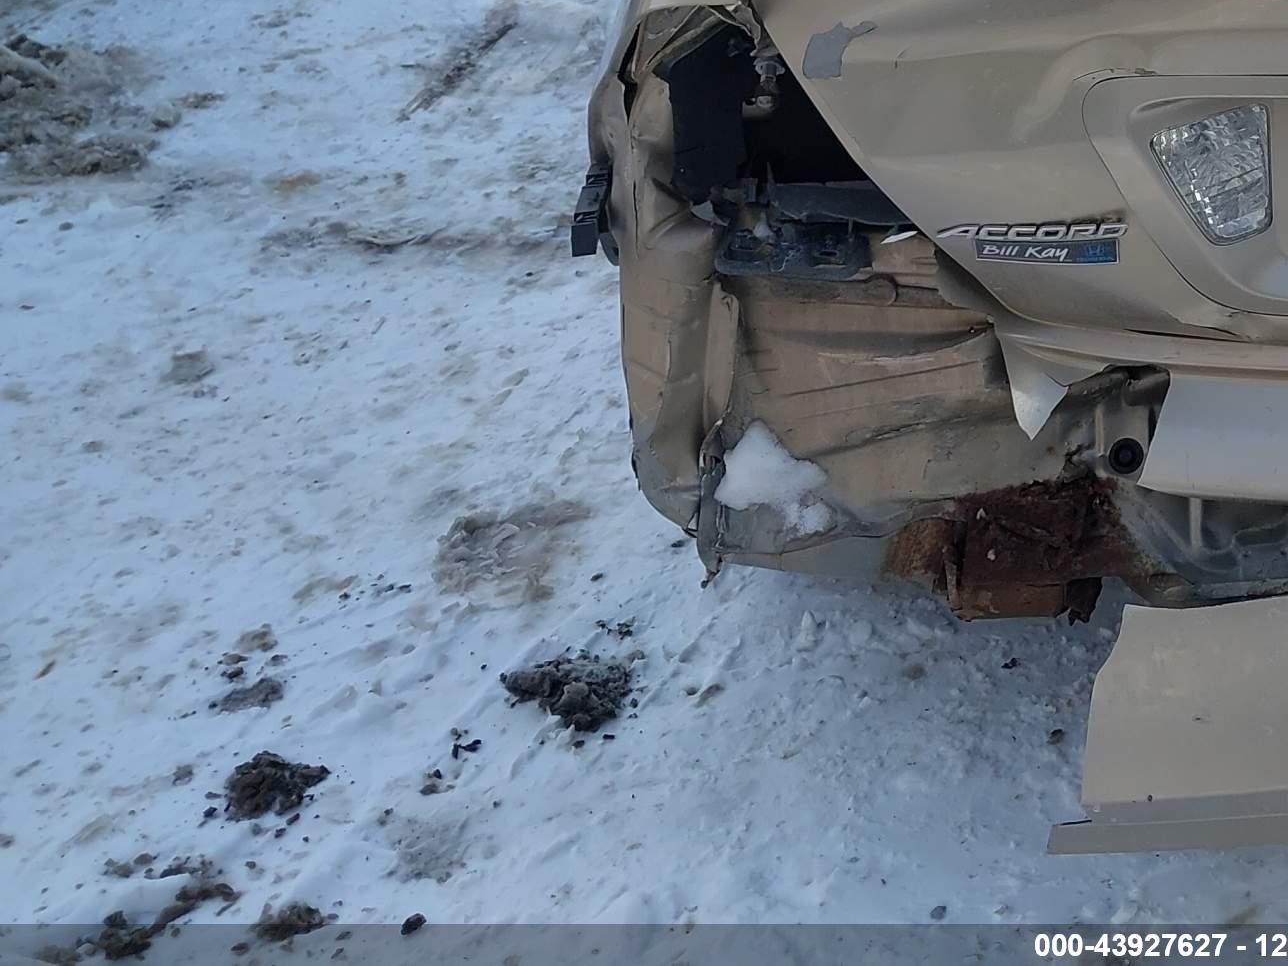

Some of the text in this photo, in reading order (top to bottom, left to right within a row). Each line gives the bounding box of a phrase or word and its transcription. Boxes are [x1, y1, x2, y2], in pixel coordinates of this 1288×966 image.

[936, 223, 1128, 240] ACCORD
[982, 244, 1018, 255] Bill
[1025, 246, 1069, 262] Kay
